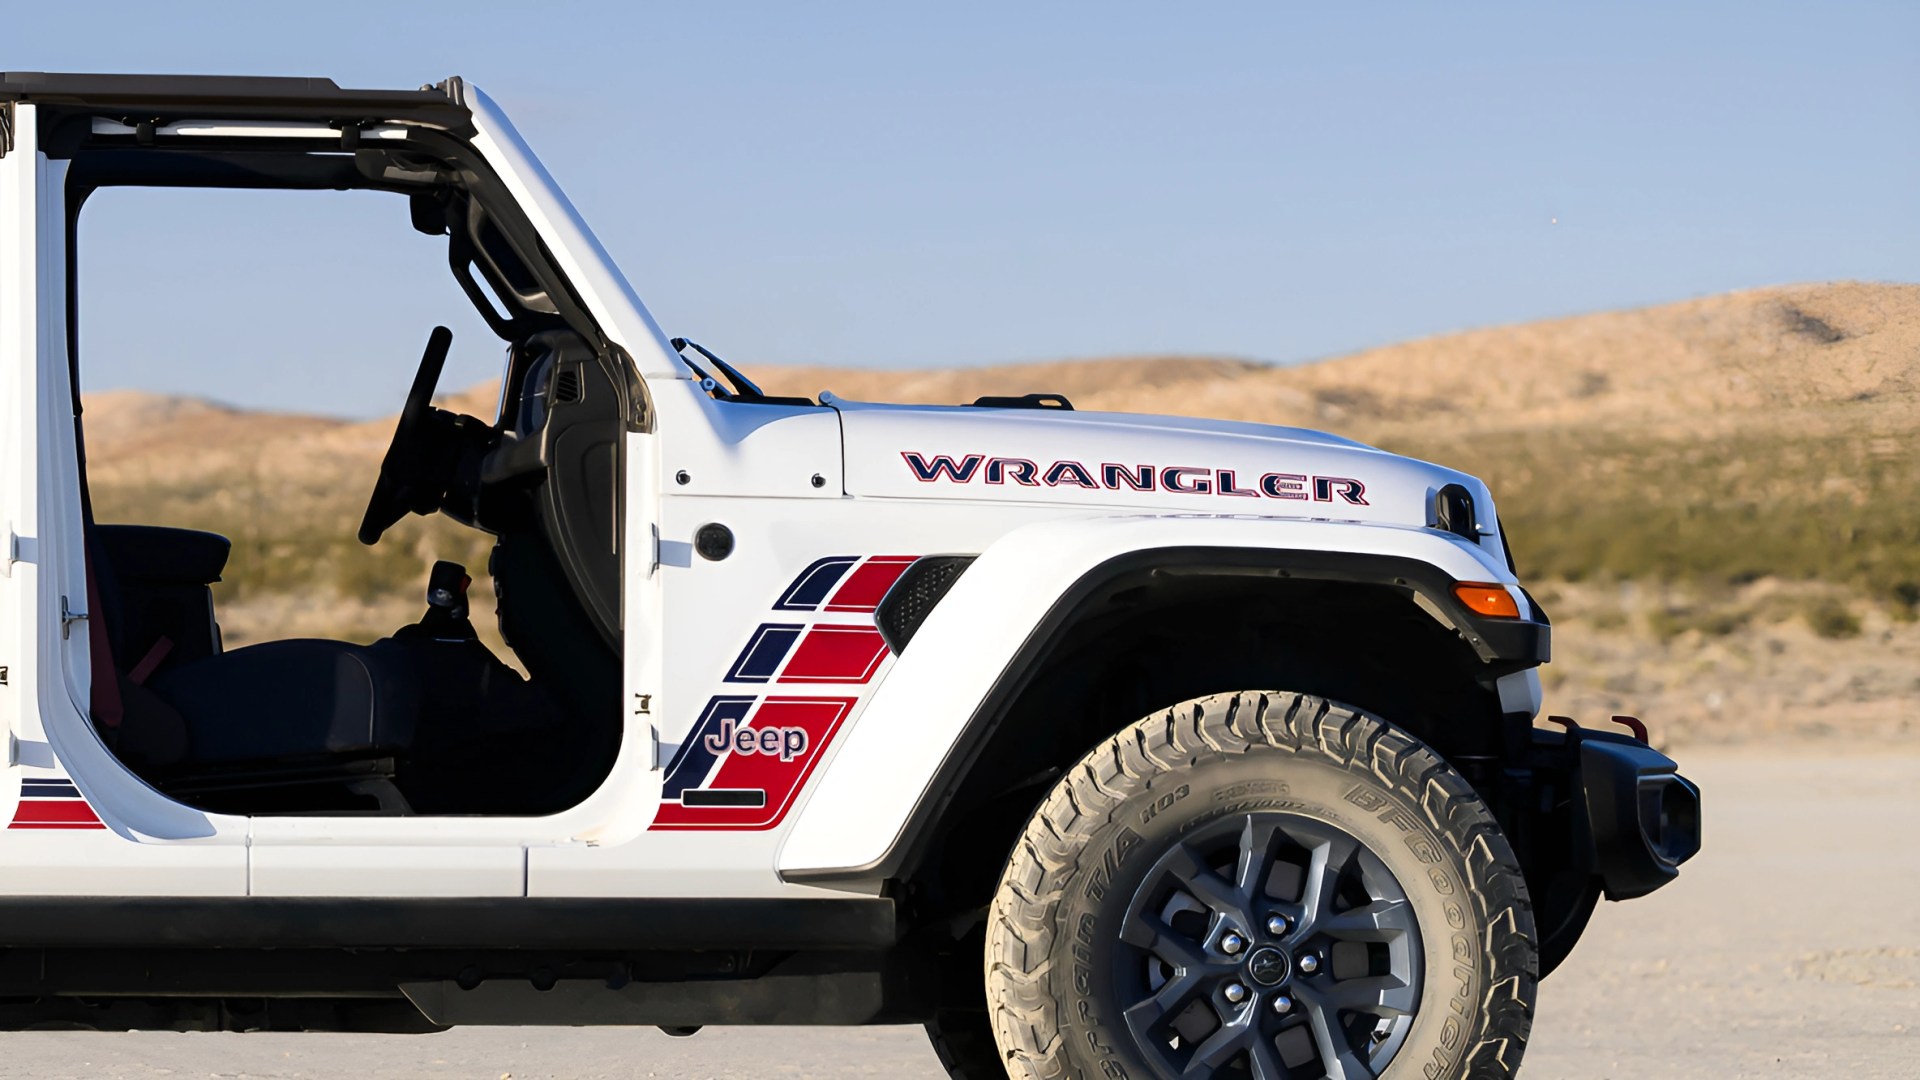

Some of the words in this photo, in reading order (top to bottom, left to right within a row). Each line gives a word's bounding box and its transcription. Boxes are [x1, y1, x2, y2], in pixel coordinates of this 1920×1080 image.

[900, 451, 1370, 506] WRANGLER
[705, 718, 809, 762] Jeep
[1084, 826, 1146, 902] T/A
[1343, 783, 1475, 1080] BFGoodrich
[1072, 911, 1130, 1080] errain
